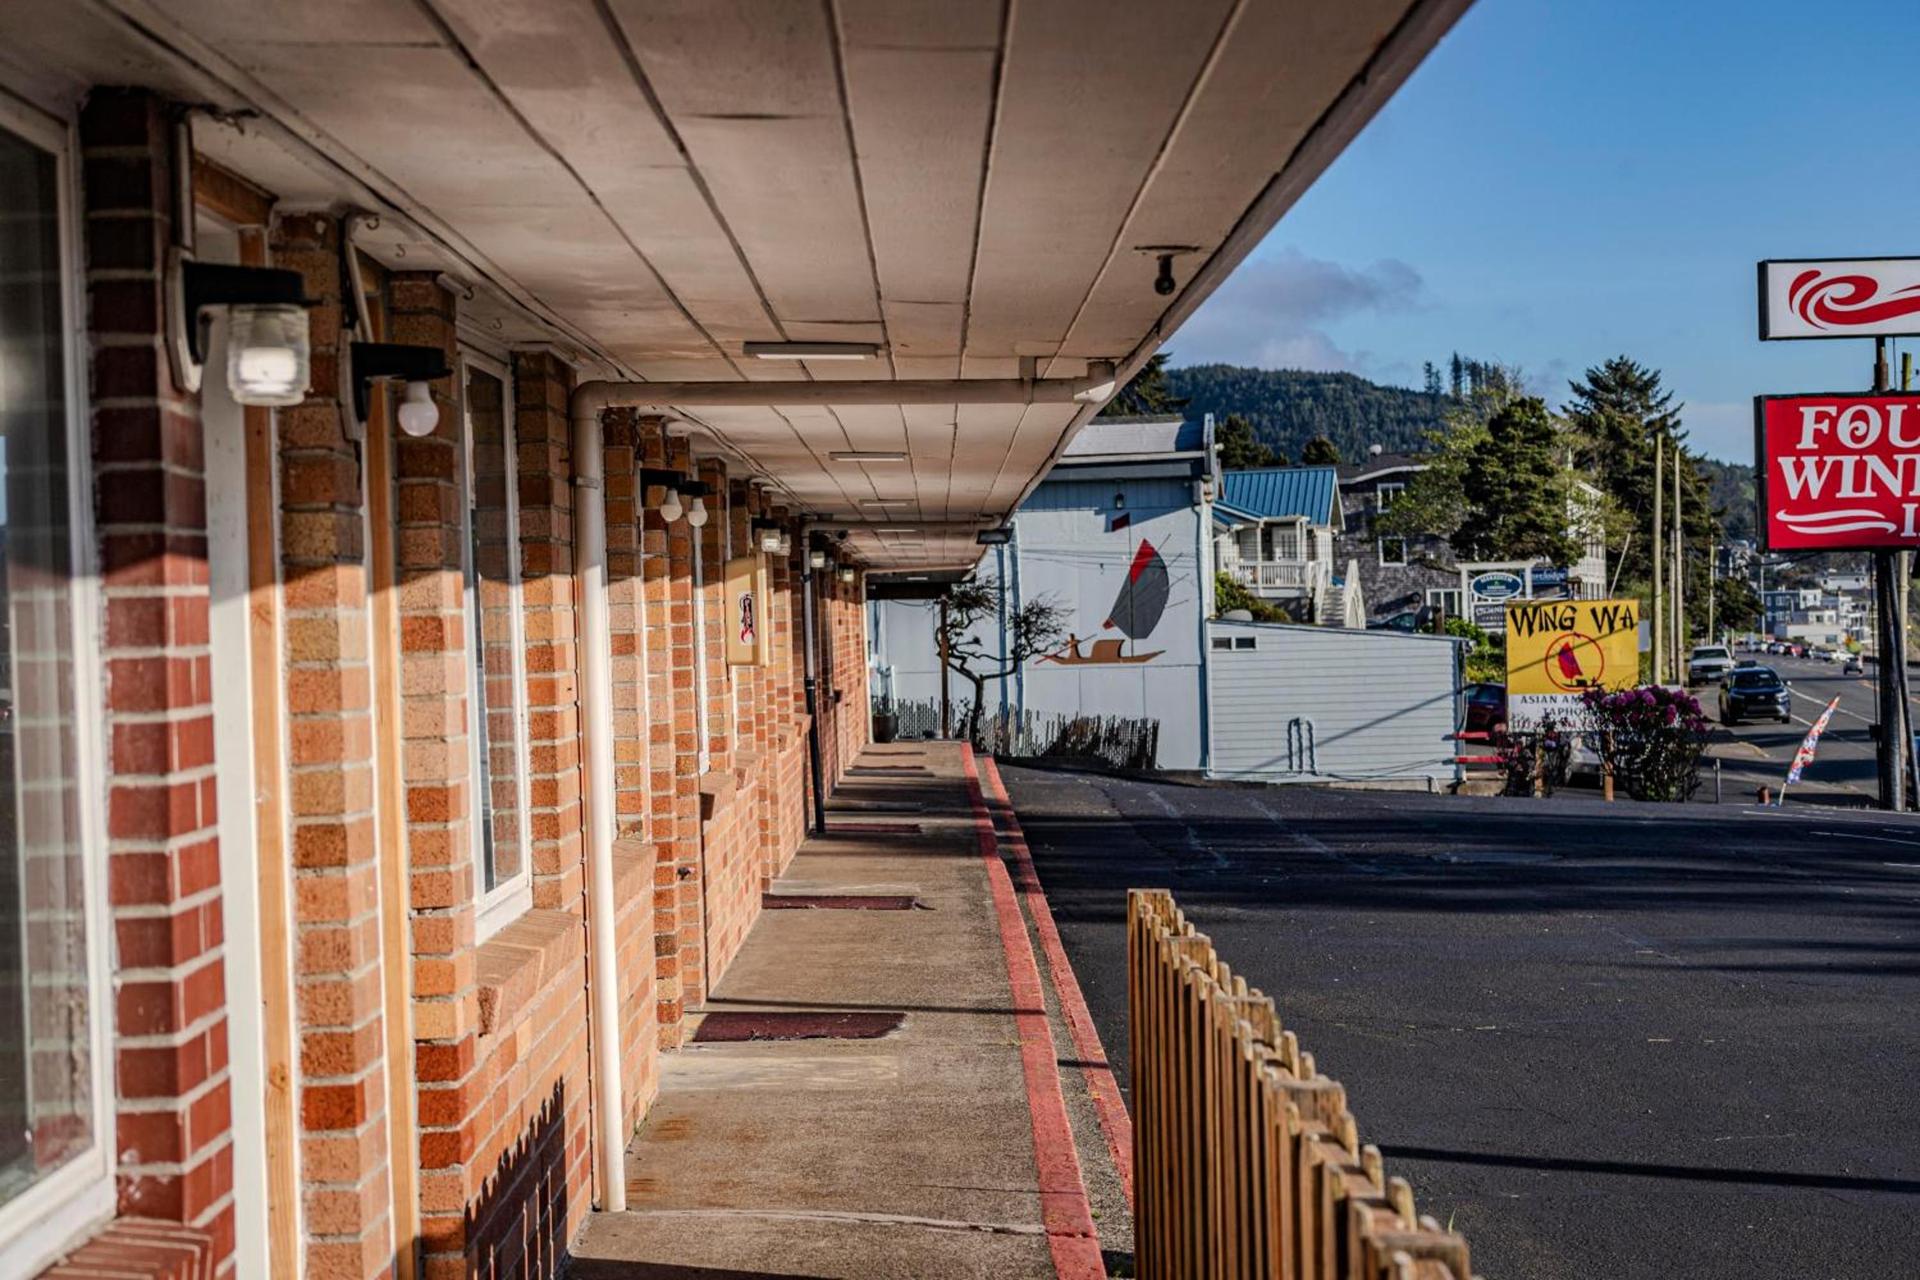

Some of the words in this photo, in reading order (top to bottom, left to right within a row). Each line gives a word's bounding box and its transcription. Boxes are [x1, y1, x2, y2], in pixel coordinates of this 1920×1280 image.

[1509, 605, 1578, 638] WING
[1590, 604, 1634, 634] WA
[1520, 695, 1557, 704] ASIAN
[1563, 695, 1583, 704] AM
